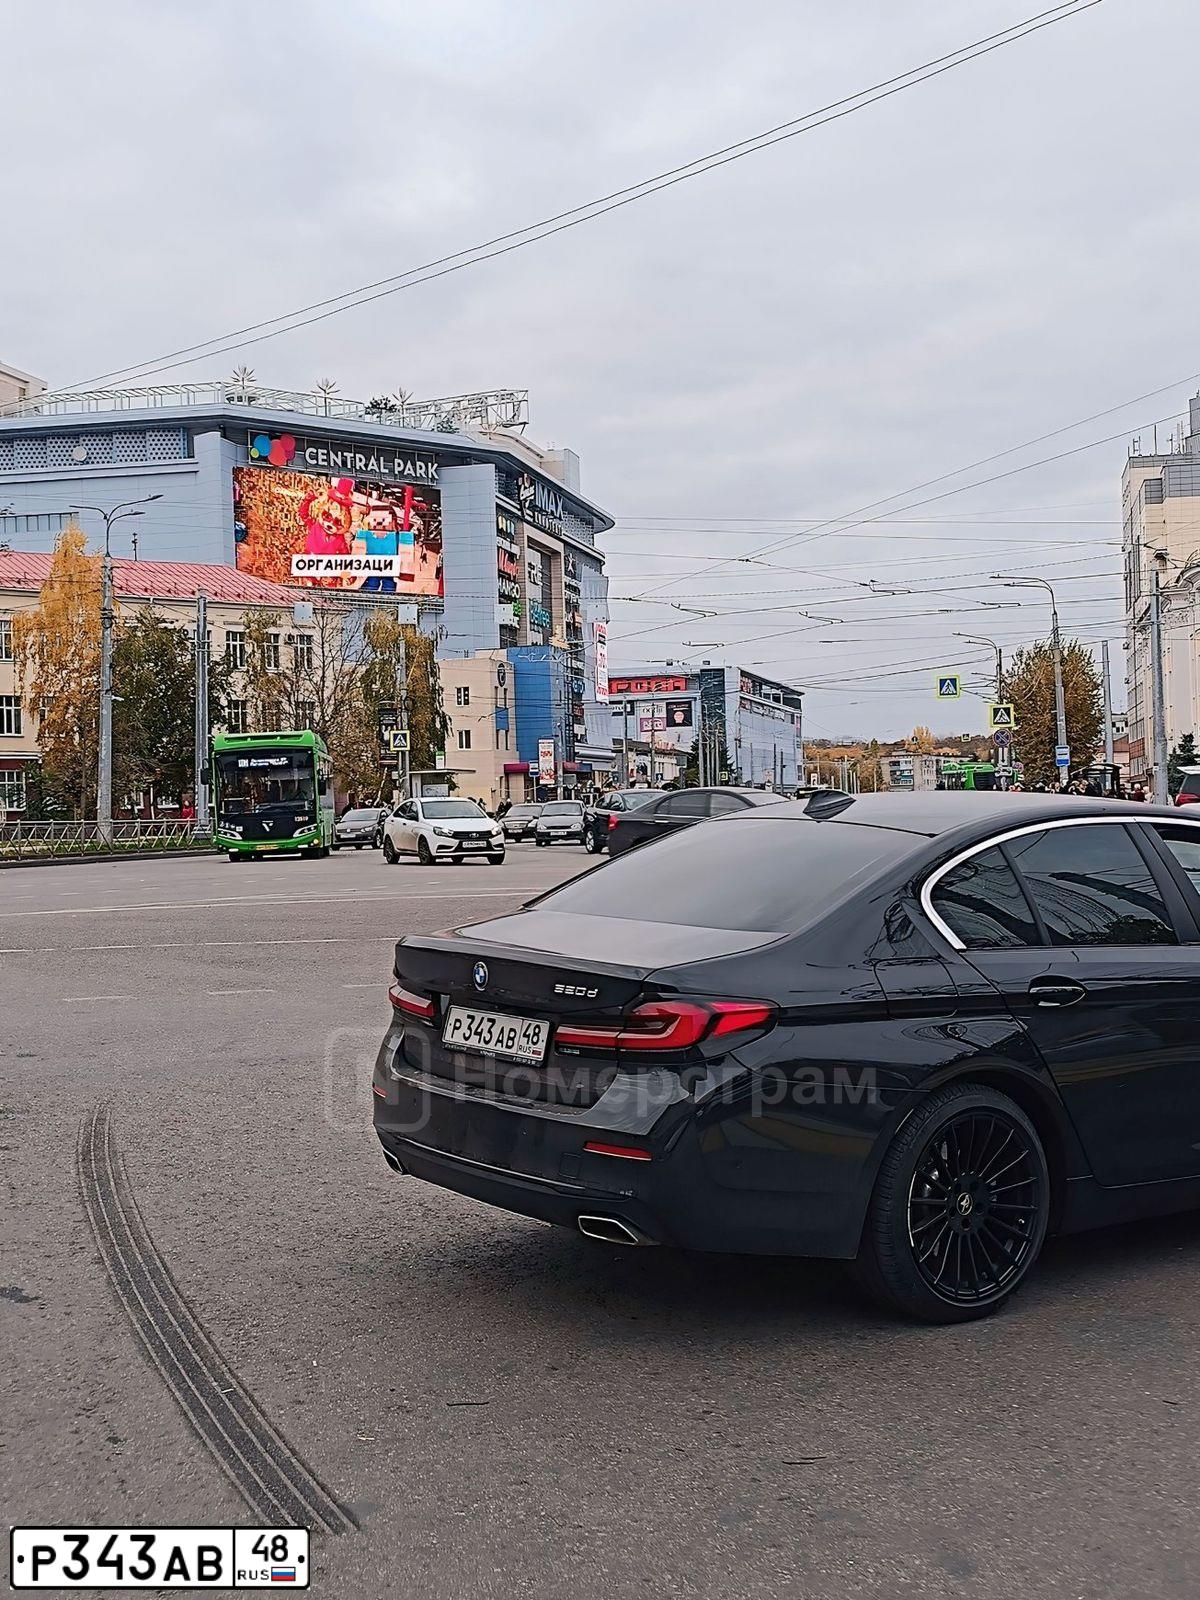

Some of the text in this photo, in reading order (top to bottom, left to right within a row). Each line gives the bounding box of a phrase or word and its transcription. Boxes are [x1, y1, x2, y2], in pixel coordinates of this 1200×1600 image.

[304, 447, 439, 479] CENTRAL PARK
[535, 481, 563, 521] IMAX
[295, 558, 393, 572] ОРГАНИЗАЦИ
[451, 1014, 542, 1050] Р343АВ 48
[518, 1044, 532, 1054] RUS
